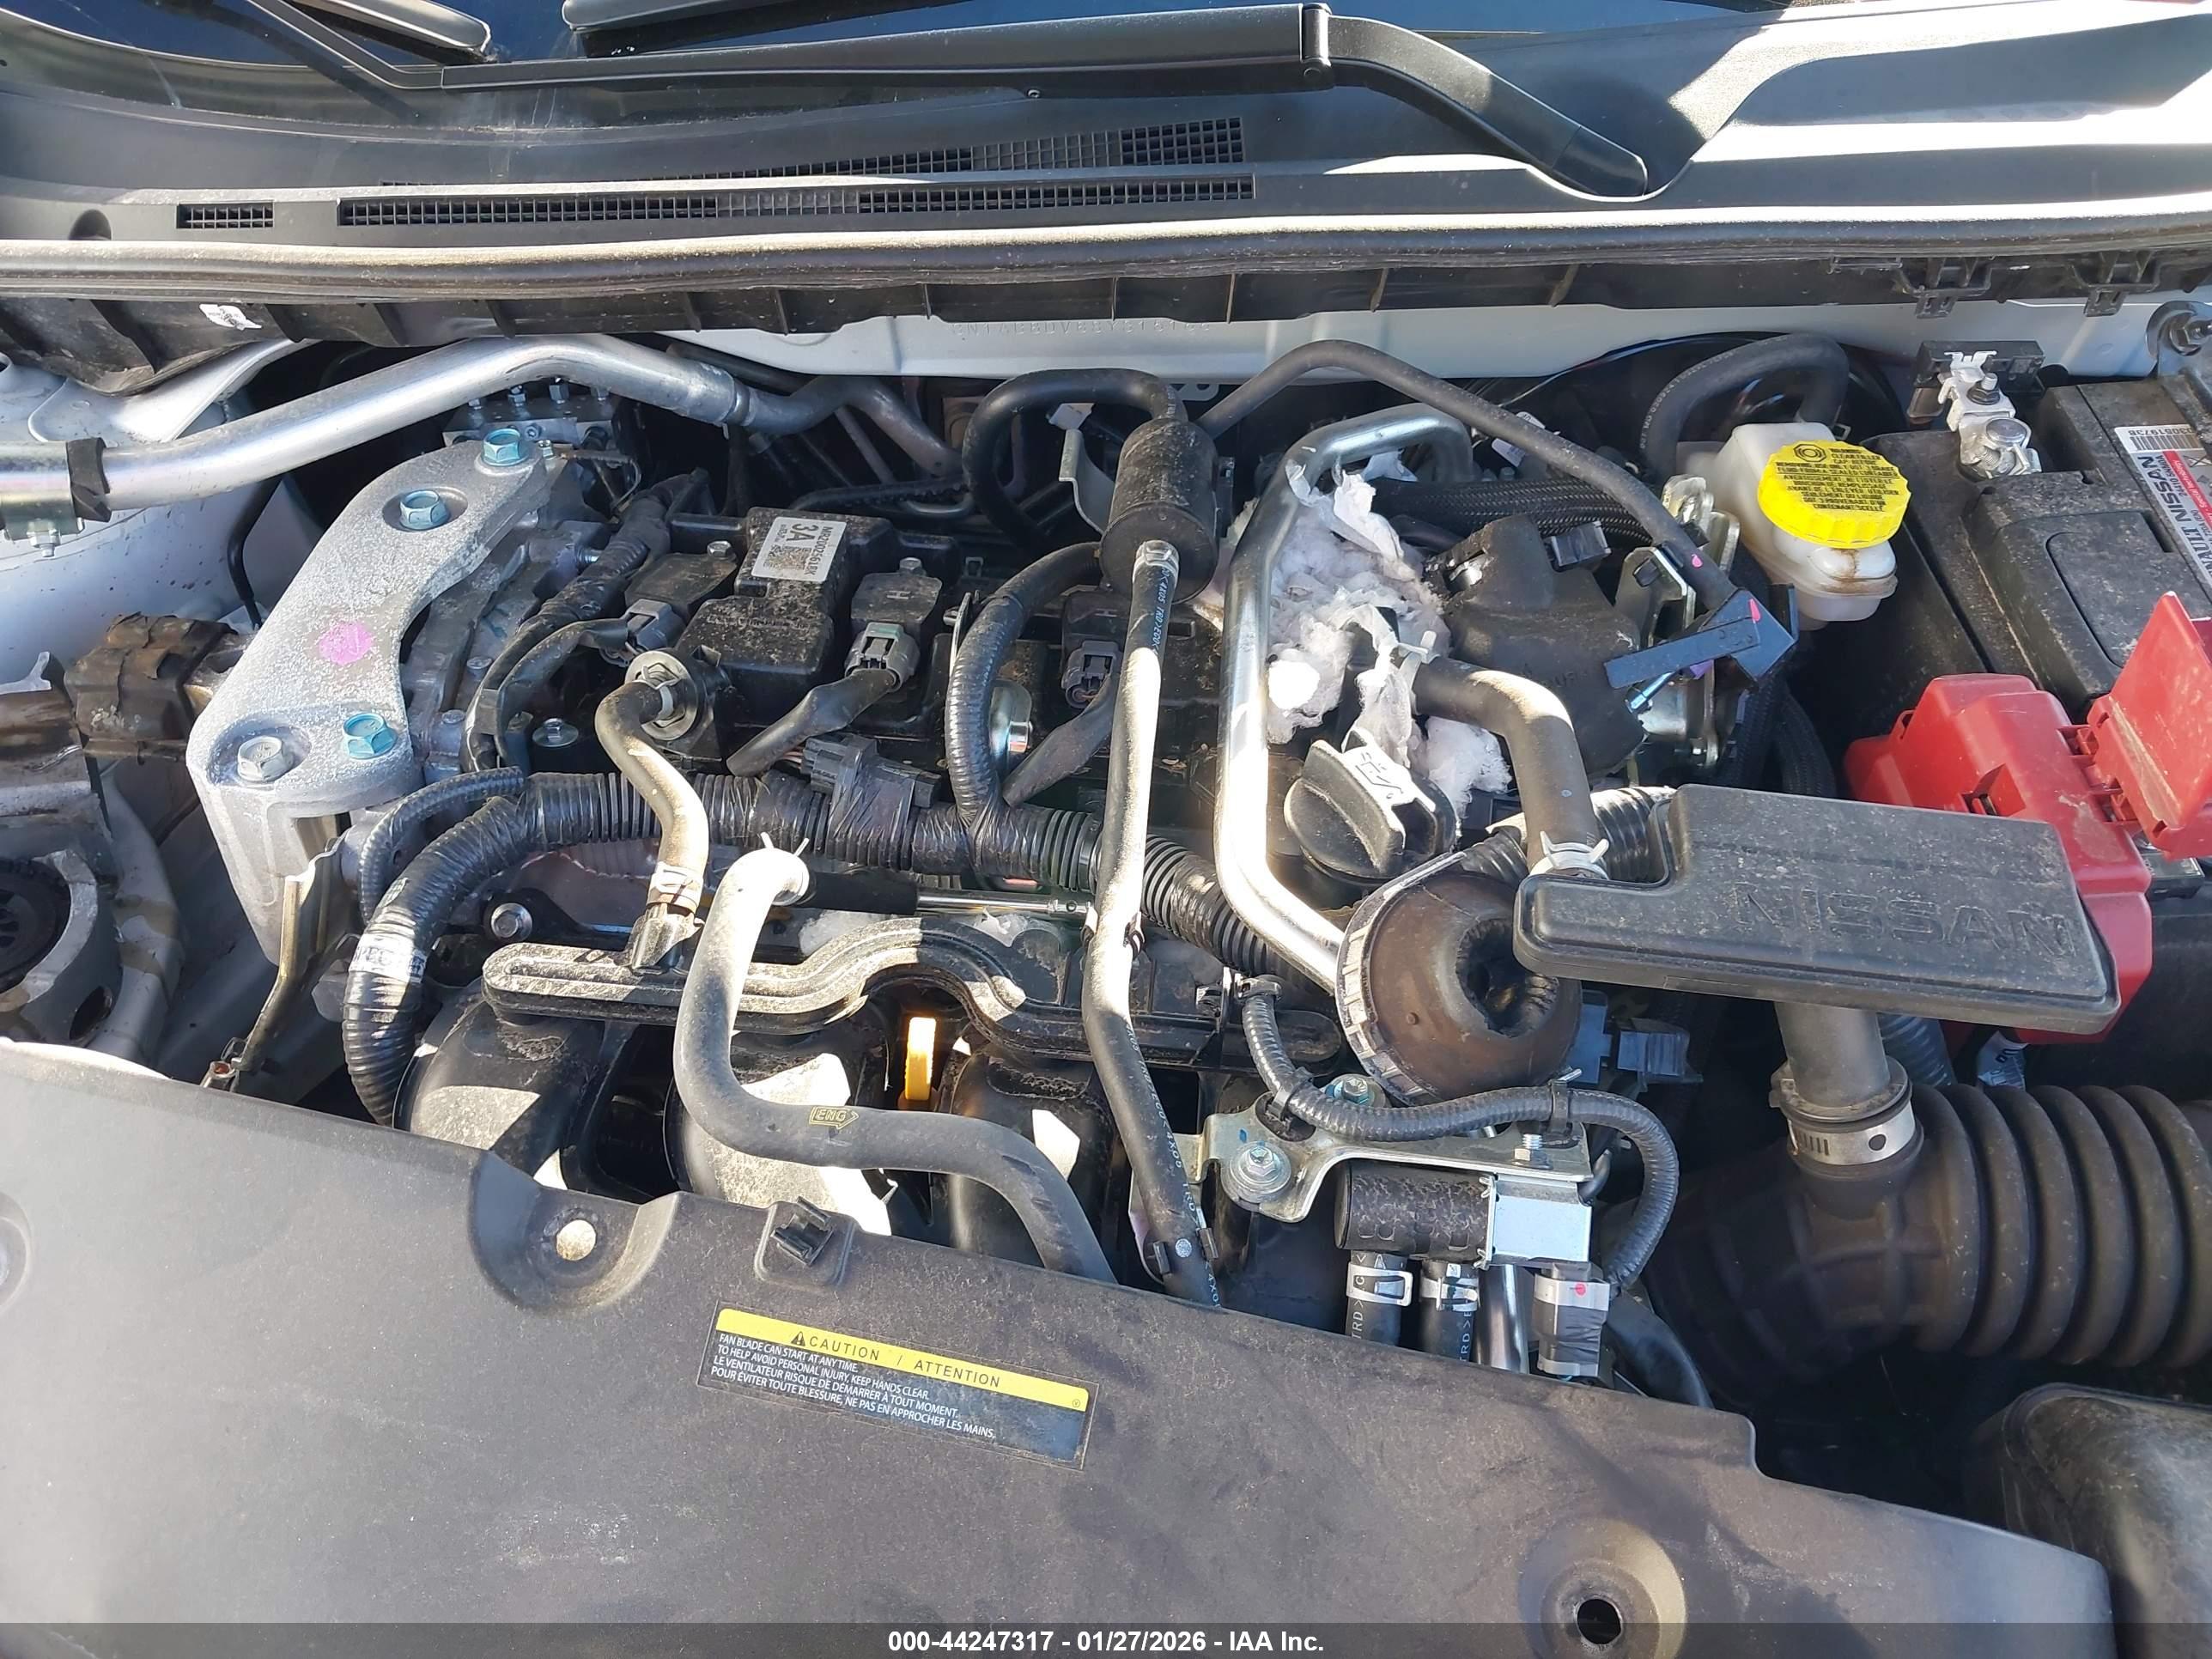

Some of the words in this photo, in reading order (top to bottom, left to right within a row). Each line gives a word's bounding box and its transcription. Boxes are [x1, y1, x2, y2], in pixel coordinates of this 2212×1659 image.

[2138, 455, 2193, 522] NISSAN
[786, 523, 819, 542] 3A
[1729, 881, 2080, 957] NISSAN
[815, 1109, 846, 1122] ENG
[718, 1344, 729, 1355] TO
[730, 1347, 751, 1360] HELP
[751, 1352, 778, 1365] AVOID
[778, 1359, 820, 1376] PERSONAL
[820, 1368, 850, 1383] INJURY,
[851, 1374, 872, 1386] KEEP
[872, 1379, 901, 1393] HANDS
[902, 1386, 930, 1400] CLEAR.
[719, 1333, 736, 1344] FAN
[736, 1336, 764, 1352] BLADE
[764, 1343, 783, 1355] CAN
[782, 1347, 808, 1361] START
[808, 1353, 821, 1364] AT
[809, 1336, 880, 1361] CAUTION
[914, 1360, 1000, 1388] ATTENTION
[711, 1366, 736, 1380] POUR
[737, 1370, 768, 1388] ÉVITER
[768, 1379, 800, 1394] TOUTE
[799, 1386, 843, 1406] BLESSURE,
[845, 1397, 858, 1408] NE
[859, 1399, 876, 1412] PAS
[877, 1404, 890, 1416] EN
[891, 1407, 945, 1427] APPROCHER
[946, 1419, 962, 1431] LES
[714, 1355, 726, 1365] LE
[726, 1357, 784, 1379] VENTILATEUR
[784, 1370, 817, 1387] RISQUE
[818, 1378, 831, 1389] DE
[832, 1380, 881, 1402] DÉMARRER
[881, 1390, 890, 1403] À
[891, 1395, 915, 1408] TOUT
[916, 1400, 958, 1418] MOMENT.
